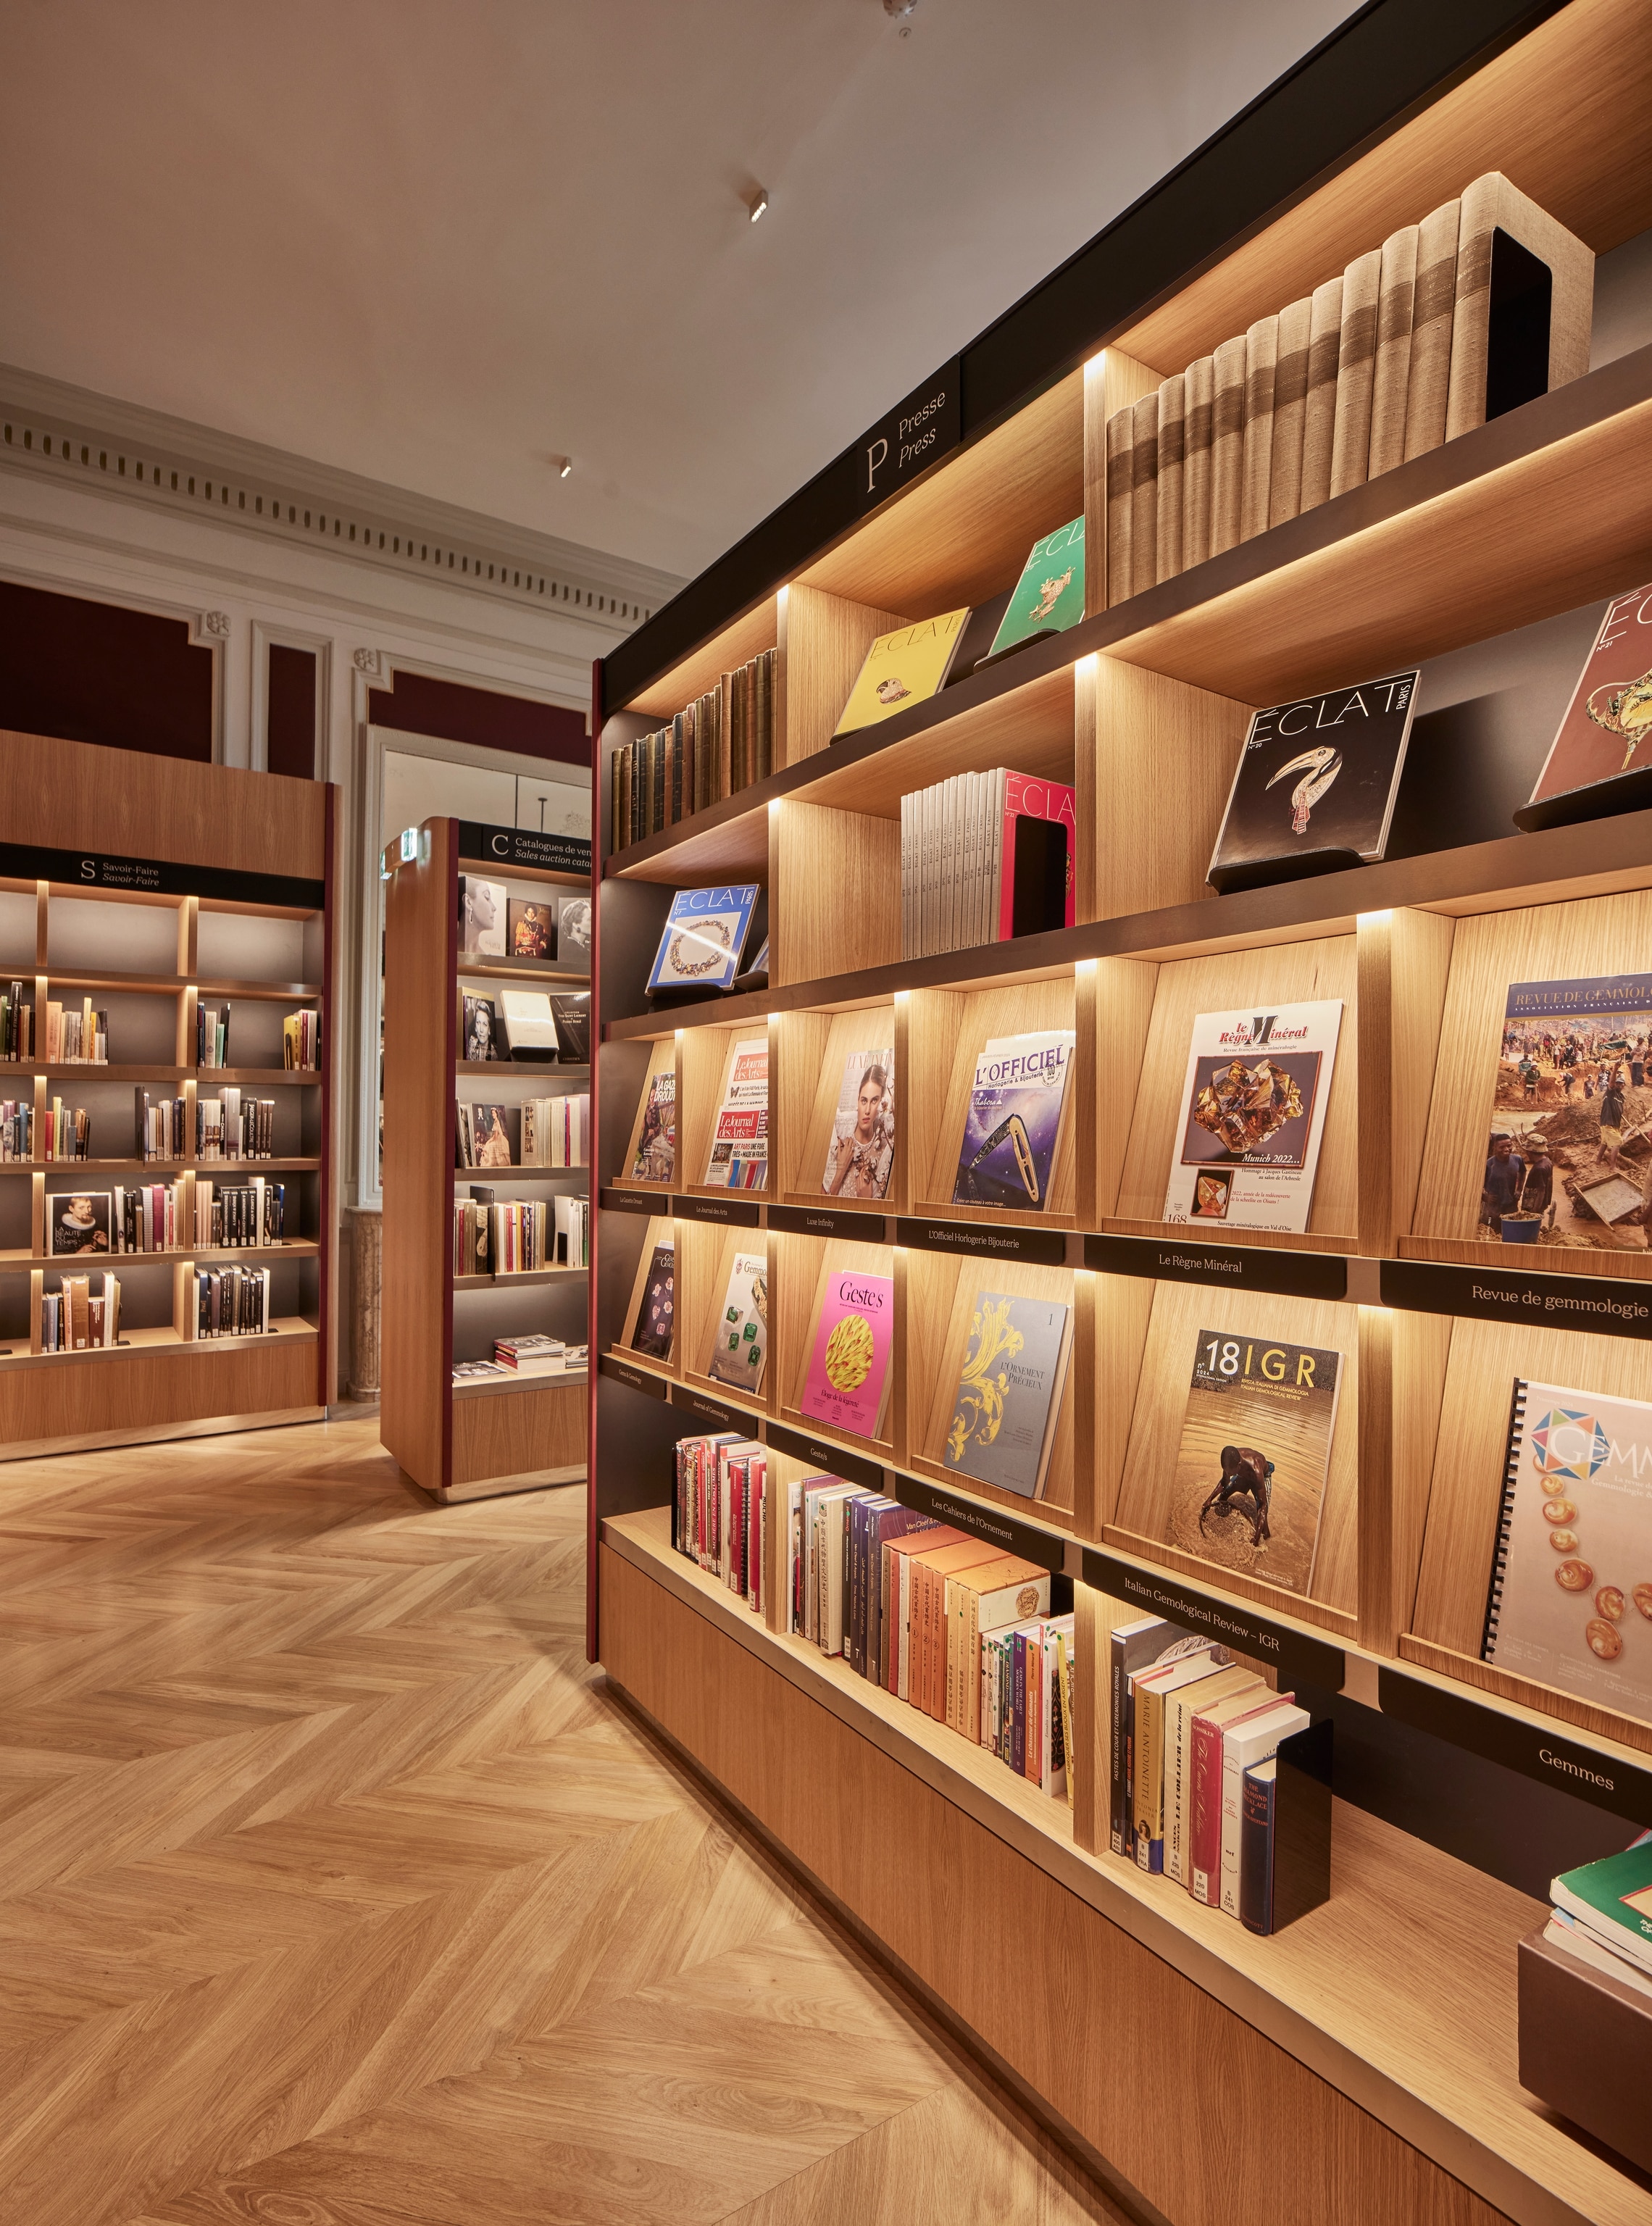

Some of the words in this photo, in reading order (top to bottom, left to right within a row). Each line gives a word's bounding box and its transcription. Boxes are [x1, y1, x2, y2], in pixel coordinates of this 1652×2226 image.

[899, 393, 946, 440] Presse
[898, 428, 936, 469] Press
[867, 438, 888, 493] P
[1396, 684, 1411, 711] PARIS
[1249, 678, 1413, 745] ÉCLAT
[492, 835, 509, 855] C
[515, 837, 564, 852] Catalogues
[565, 844, 575, 854] de
[515, 849, 538, 861] Sales
[540, 854, 571, 864] auction
[80, 860, 96, 879] S
[103, 862, 159, 876] Savoir-Faire
[102, 872, 159, 886] Savoir-Faire
[675, 887, 755, 911] ÉCLAT
[745, 891, 754, 904] PARIS
[1516, 992, 1562, 1005] REVUE
[1564, 991, 1582, 1004] DE
[1236, 1022, 1247, 1033] le
[1219, 1032, 1254, 1043] Règne
[846, 1055, 868, 1070] LUXE
[976, 1044, 1065, 1085] L'OFFICIEL
[656, 1081, 664, 1091] LA
[988, 1078, 1013, 1089] Horlogerie
[1019, 1072, 1043, 1082] Bijouterie
[729, 1114, 754, 1127] Journal
[730, 1126, 746, 1138] Arts
[1241, 1154, 1270, 1164] Munich
[806, 1217, 817, 1226] Luxe
[818, 1218, 834, 1228] Infinity
[929, 1230, 954, 1241] L'Officiel
[954, 1233, 987, 1246] Horlogerie
[988, 1235, 1019, 1248] Bijouterie
[1159, 1254, 1171, 1265] Le
[1172, 1255, 1202, 1270] Règne
[1204, 1258, 1242, 1272] Minéral
[840, 1281, 883, 1309] Geste/s
[1472, 1285, 1519, 1303] Revue
[1522, 1291, 1541, 1305] de
[1545, 1296, 1649, 1319] gemmologie
[1206, 1340, 1240, 1375] 18
[1244, 1345, 1316, 1388] IGR
[629, 1373, 642, 1385] Gemology
[1008, 1372, 1042, 1390] PRÉCIEUX
[821, 1388, 832, 1399] Éloge
[1255, 1380, 1274, 1388] ITALIANA
[1279, 1385, 1309, 1396] GEMMOLOGIA
[1255, 1386, 1285, 1398] GEMOLOGICAL
[693, 1400, 705, 1411] Journal
[709, 1406, 729, 1421] Gemmology
[810, 1447, 827, 1461] Geste/s
[1592, 1477, 1644, 1497] Gemmologie
[1625, 1478, 1643, 1487] revue
[916, 1518, 929, 1527] Cleef
[932, 1498, 942, 1509] Les
[943, 1503, 966, 1521] Cahiers
[967, 1512, 975, 1522] de
[975, 1514, 1013, 1541] l'Ornement
[1125, 1577, 1152, 1598] Italian
[1154, 1590, 1211, 1622] Gemological
[1213, 1614, 1249, 1638] Review
[1259, 1635, 1280, 1652] IGR
[1062, 1700, 1067, 1709] EN
[1028, 1717, 1033, 1726] de
[1177, 1732, 1181, 1742] de
[1141, 1731, 1150, 1801] ANTOINETTE
[1539, 1749, 1615, 1791] Gemmes
[1248, 1783, 1259, 1793] THE
[1176, 1803, 1180, 1819] LE
[1138, 1859, 1147, 1868] FRA
[1171, 1869, 1180, 1878] MOS
[1195, 1889, 1206, 1899] MOS
[1224, 1901, 1235, 1910] COS
